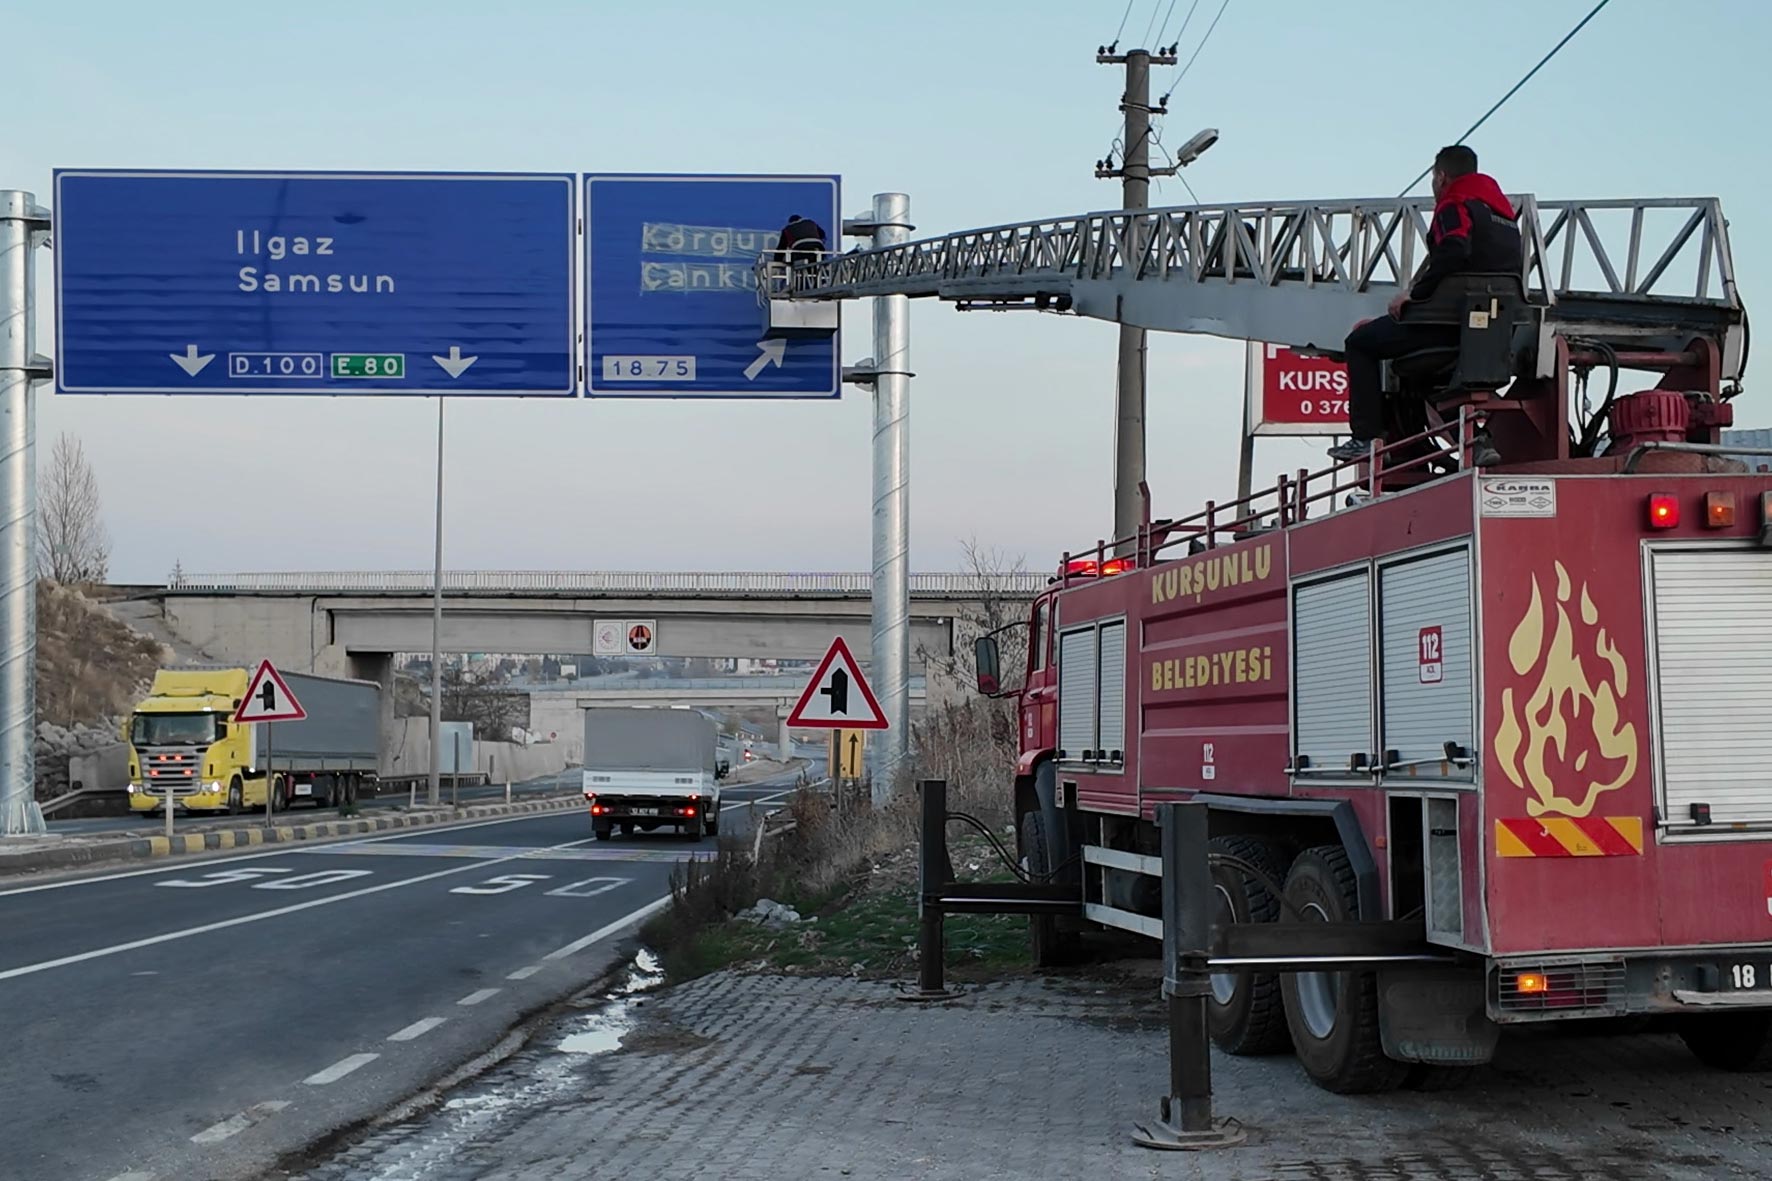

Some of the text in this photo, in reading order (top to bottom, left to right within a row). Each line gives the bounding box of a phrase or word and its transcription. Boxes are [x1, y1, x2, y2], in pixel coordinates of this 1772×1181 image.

[237, 230, 334, 260] Ilgaz
[239, 267, 395, 293] Samsun
[236, 357, 316, 374] D.100
[338, 357, 398, 374] E.80
[1279, 371, 1348, 395] KURŞ
[1300, 400, 1312, 414] 0
[1152, 544, 1271, 604] KURŞUNLU
[1422, 632, 1439, 660] 112
[1732, 964, 1755, 988] 18
